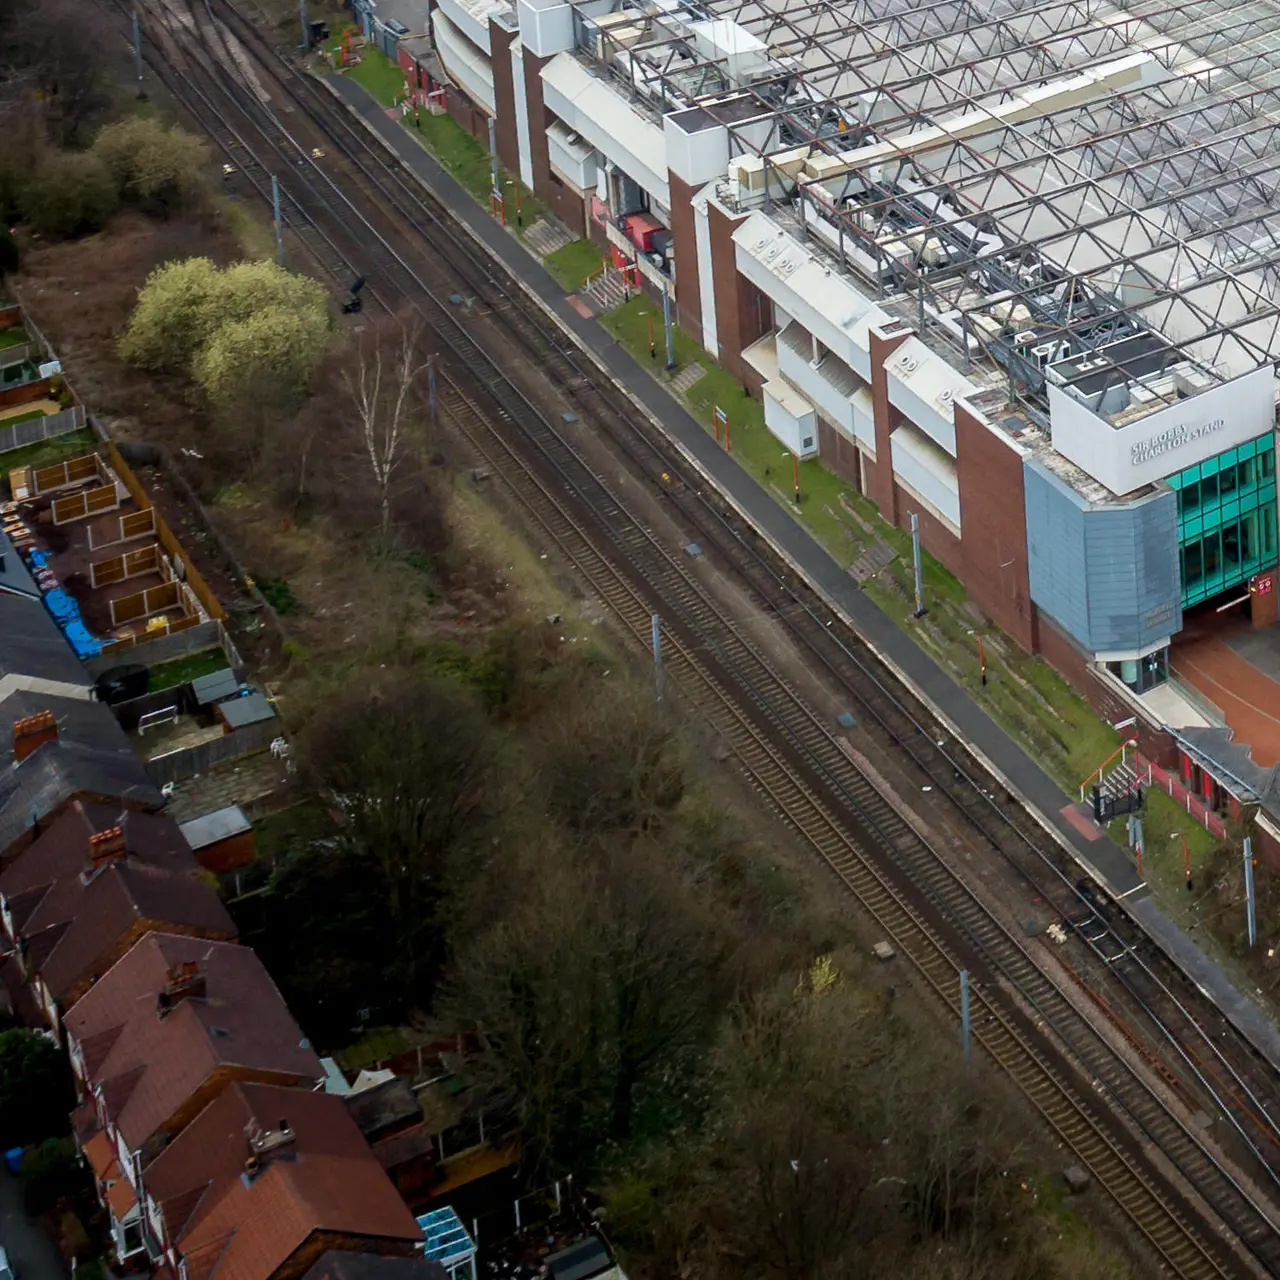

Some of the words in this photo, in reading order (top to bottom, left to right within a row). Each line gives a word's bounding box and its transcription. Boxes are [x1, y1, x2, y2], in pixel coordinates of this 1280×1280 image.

[1131, 439, 1150, 456] SIR
[1151, 423, 1188, 447] BOBBY
[1132, 436, 1190, 466] CHARLTON
[1191, 419, 1225, 441] STAND
